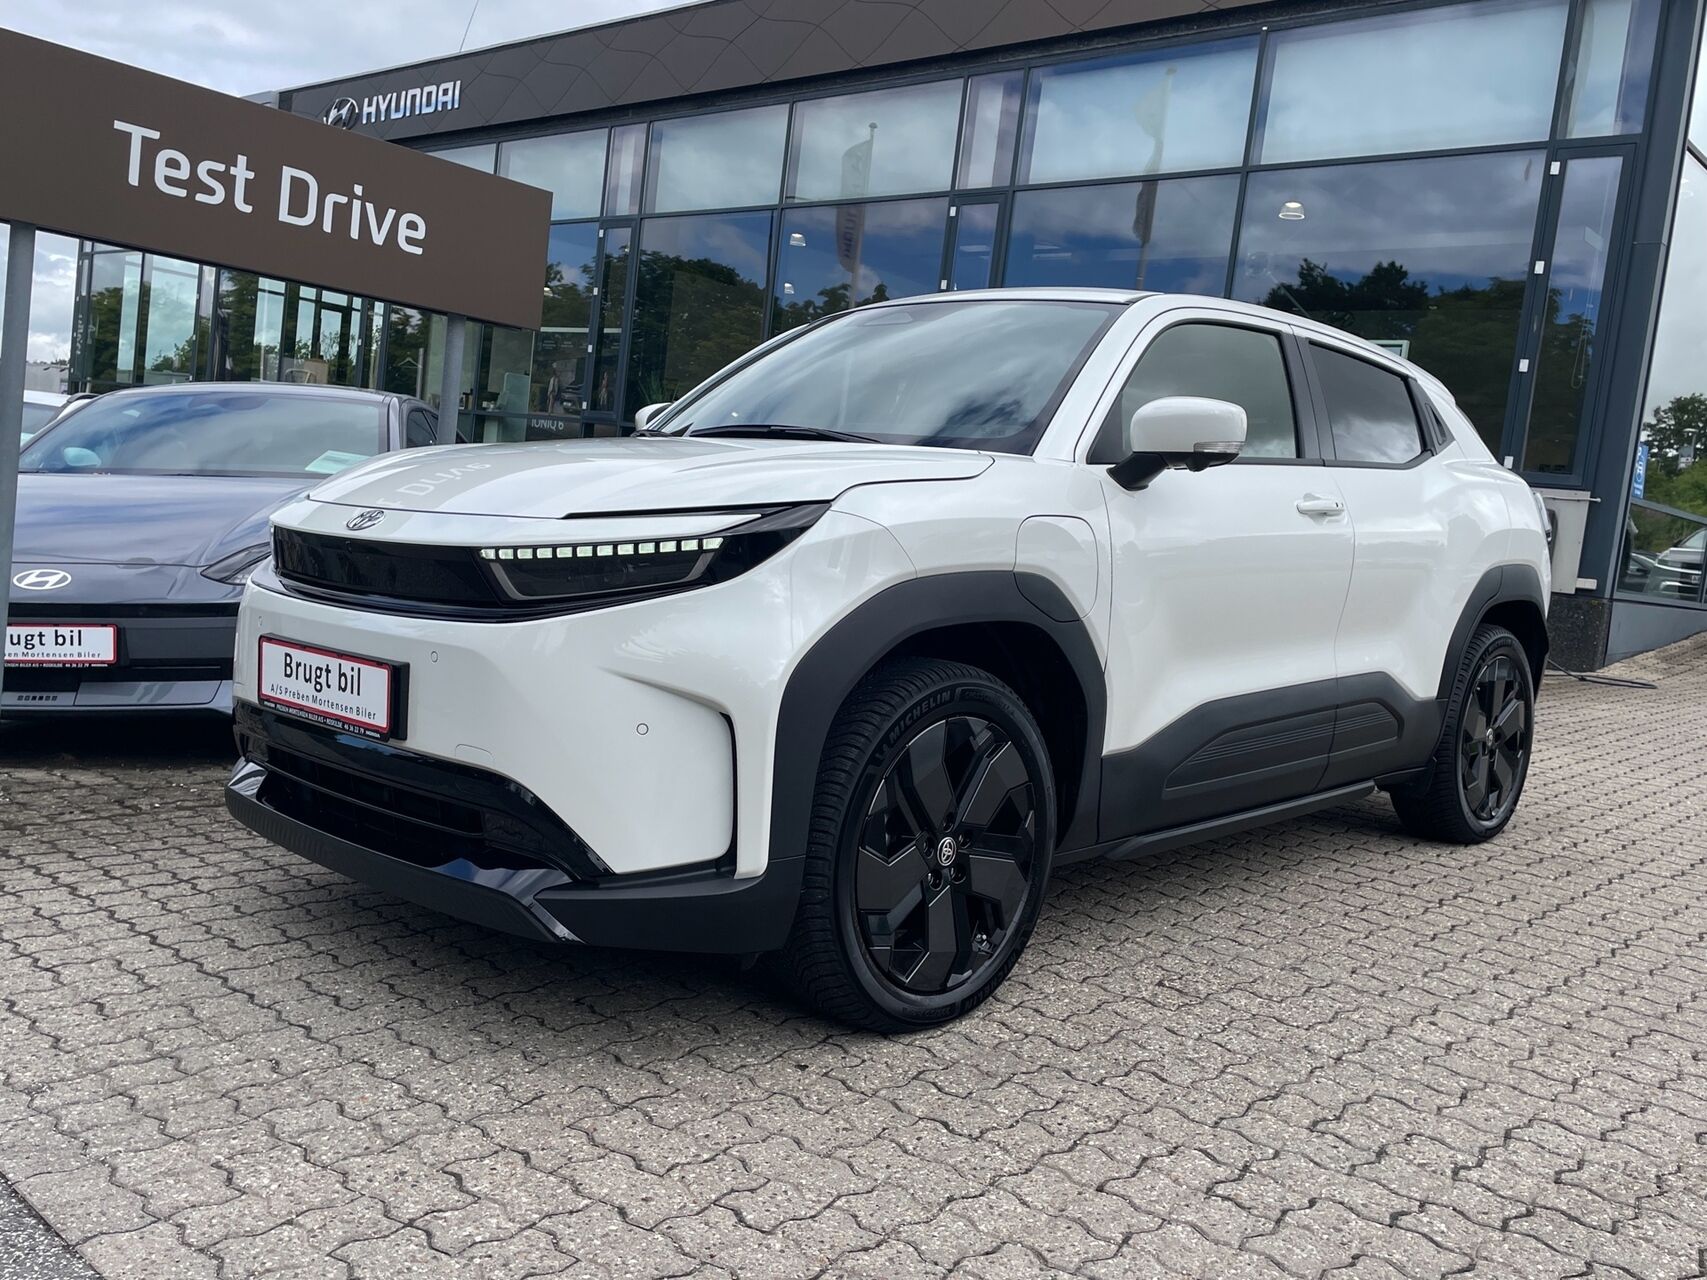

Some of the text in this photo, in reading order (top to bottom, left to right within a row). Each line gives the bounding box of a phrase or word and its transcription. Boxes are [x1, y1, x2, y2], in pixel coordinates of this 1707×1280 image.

[362, 80, 461, 124] HYUNDAI
[113, 119, 427, 256] Test Drive
[9, 629, 82, 650] ugt bil
[284, 652, 361, 696] Brugt bil
[270, 683, 377, 720] A/S Preben Mortensen Biler
[888, 690, 951, 743] MICHELIN
